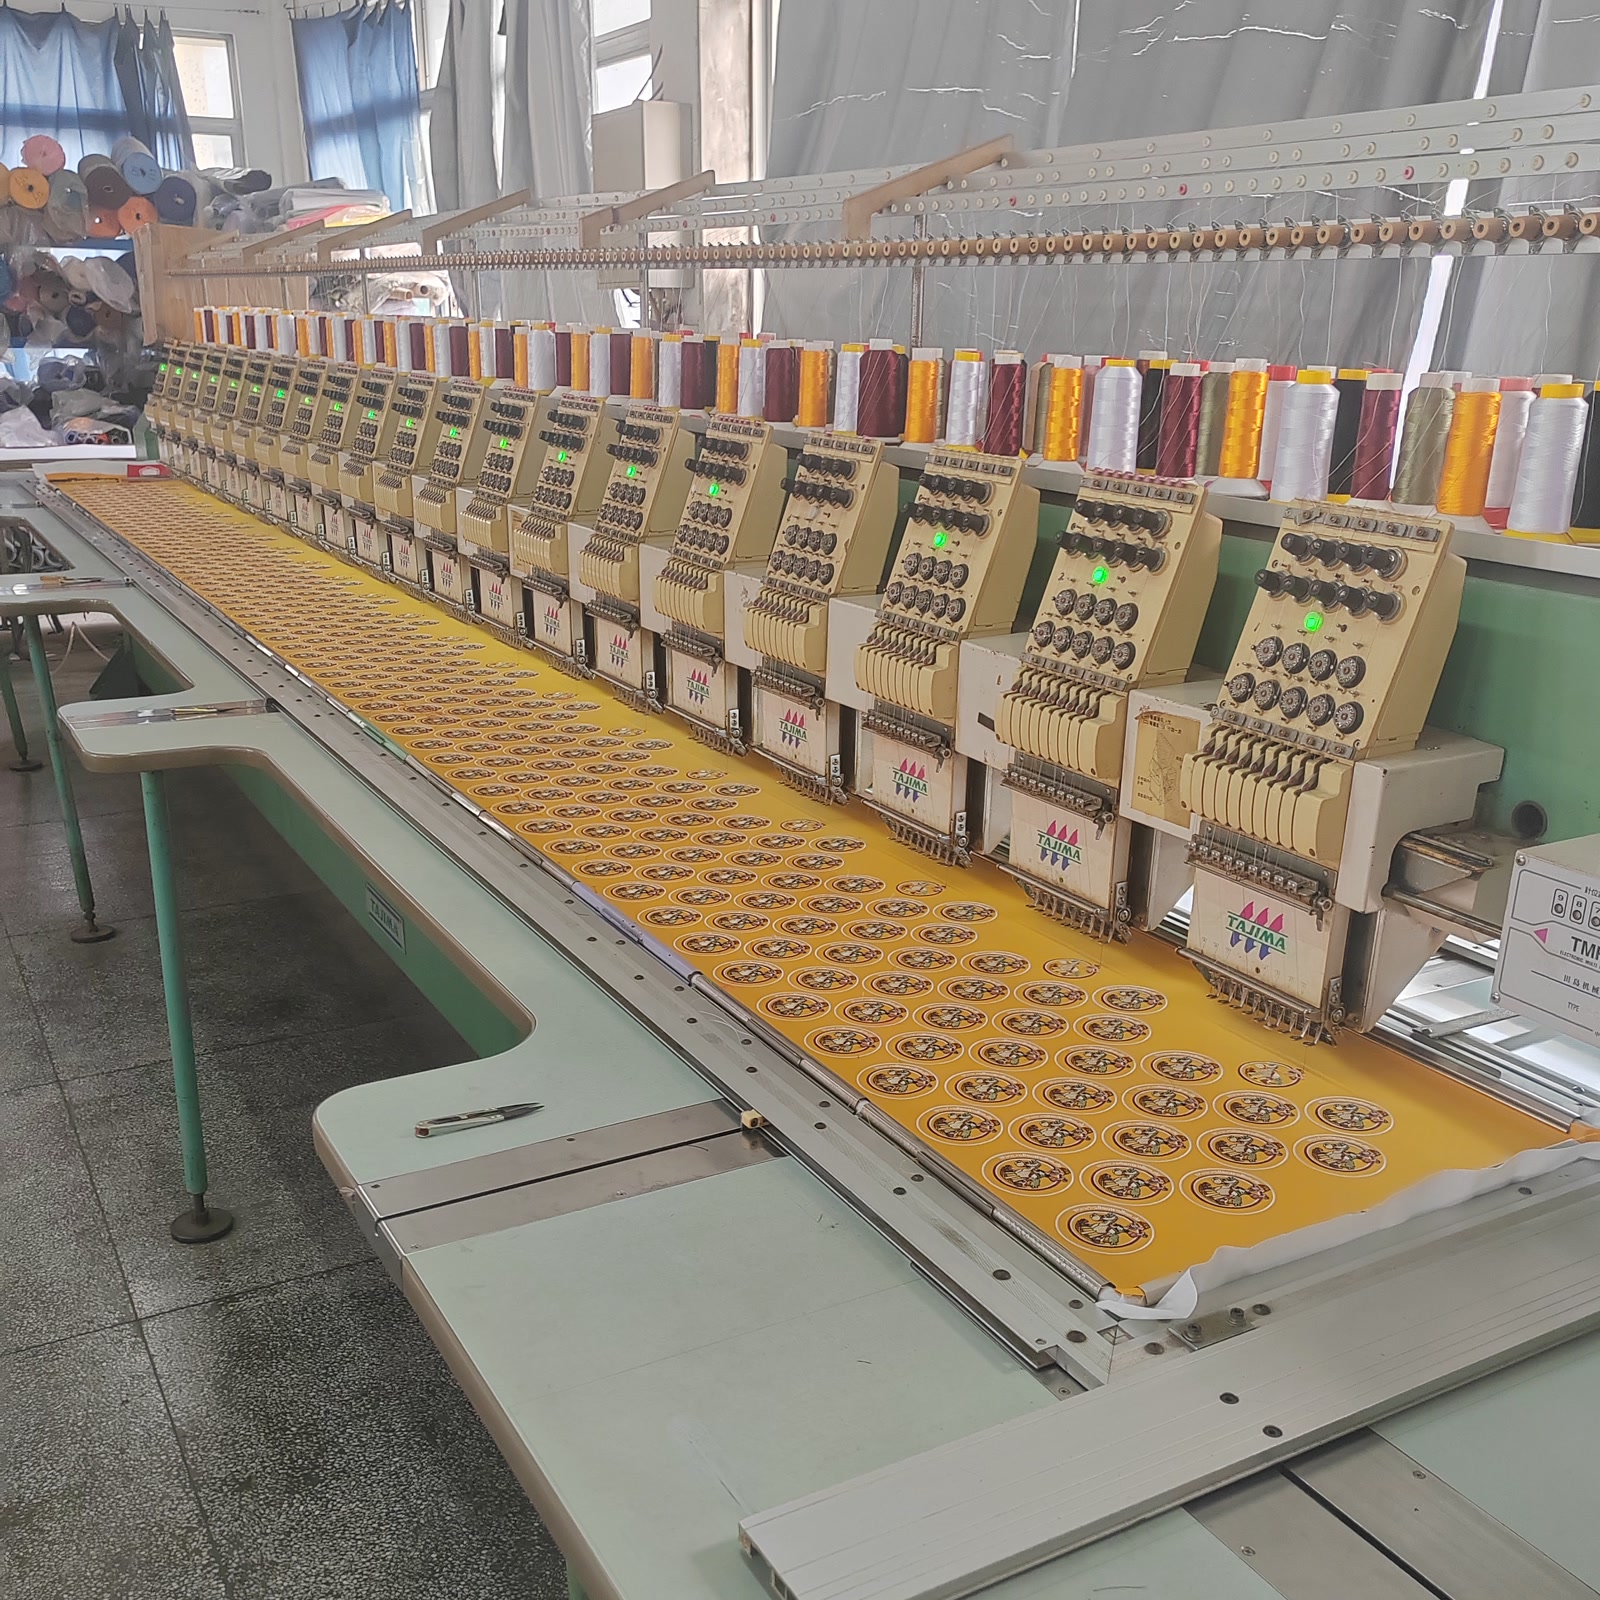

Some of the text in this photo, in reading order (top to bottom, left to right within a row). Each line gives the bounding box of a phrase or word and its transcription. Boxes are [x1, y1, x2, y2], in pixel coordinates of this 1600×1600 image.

[609, 645, 629, 660] TAJIMA
[687, 679, 710, 696] TAJIMA
[779, 721, 807, 740] TAJIMA
[892, 770, 928, 794] TAJIMA
[1037, 833, 1081, 861] TAJIMA
[1227, 915, 1286, 951] TAJIMA
[1567, 1001, 1580, 1013] TYPE
